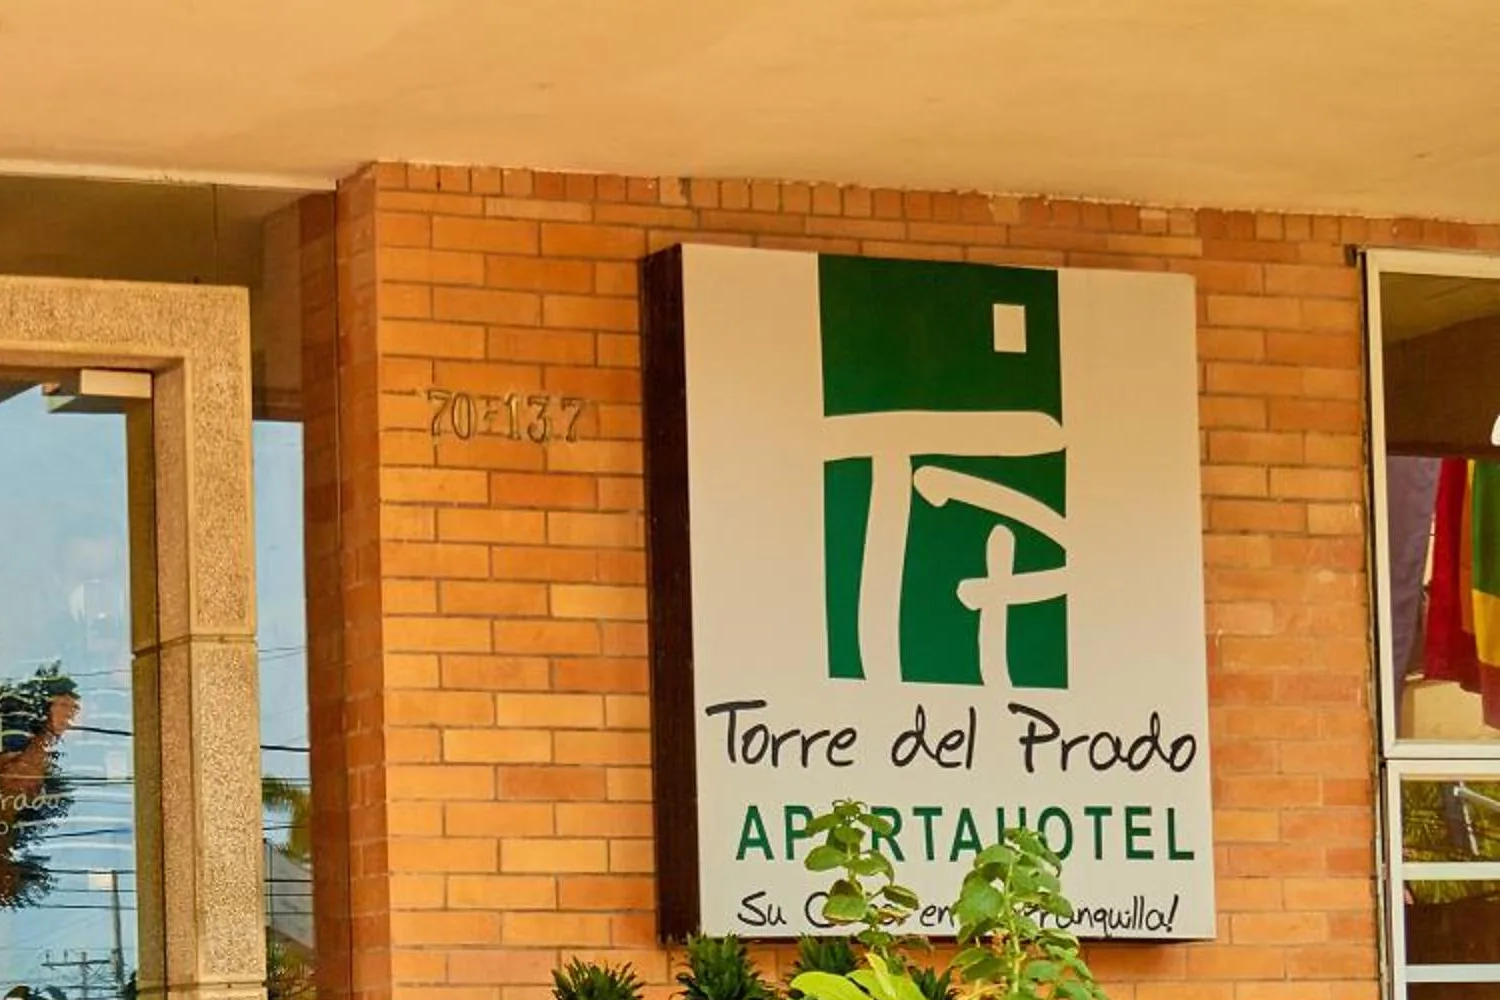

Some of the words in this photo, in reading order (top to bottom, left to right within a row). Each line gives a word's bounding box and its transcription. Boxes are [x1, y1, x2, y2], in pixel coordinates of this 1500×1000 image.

[705, 700, 858, 768] Torre
[891, 704, 977, 770] del
[1007, 702, 1198, 773] Prado
[735, 804, 1195, 862] APRTAOTEL
[737, 891, 787, 927] Su
[990, 895, 1179, 938] ranquilla!
